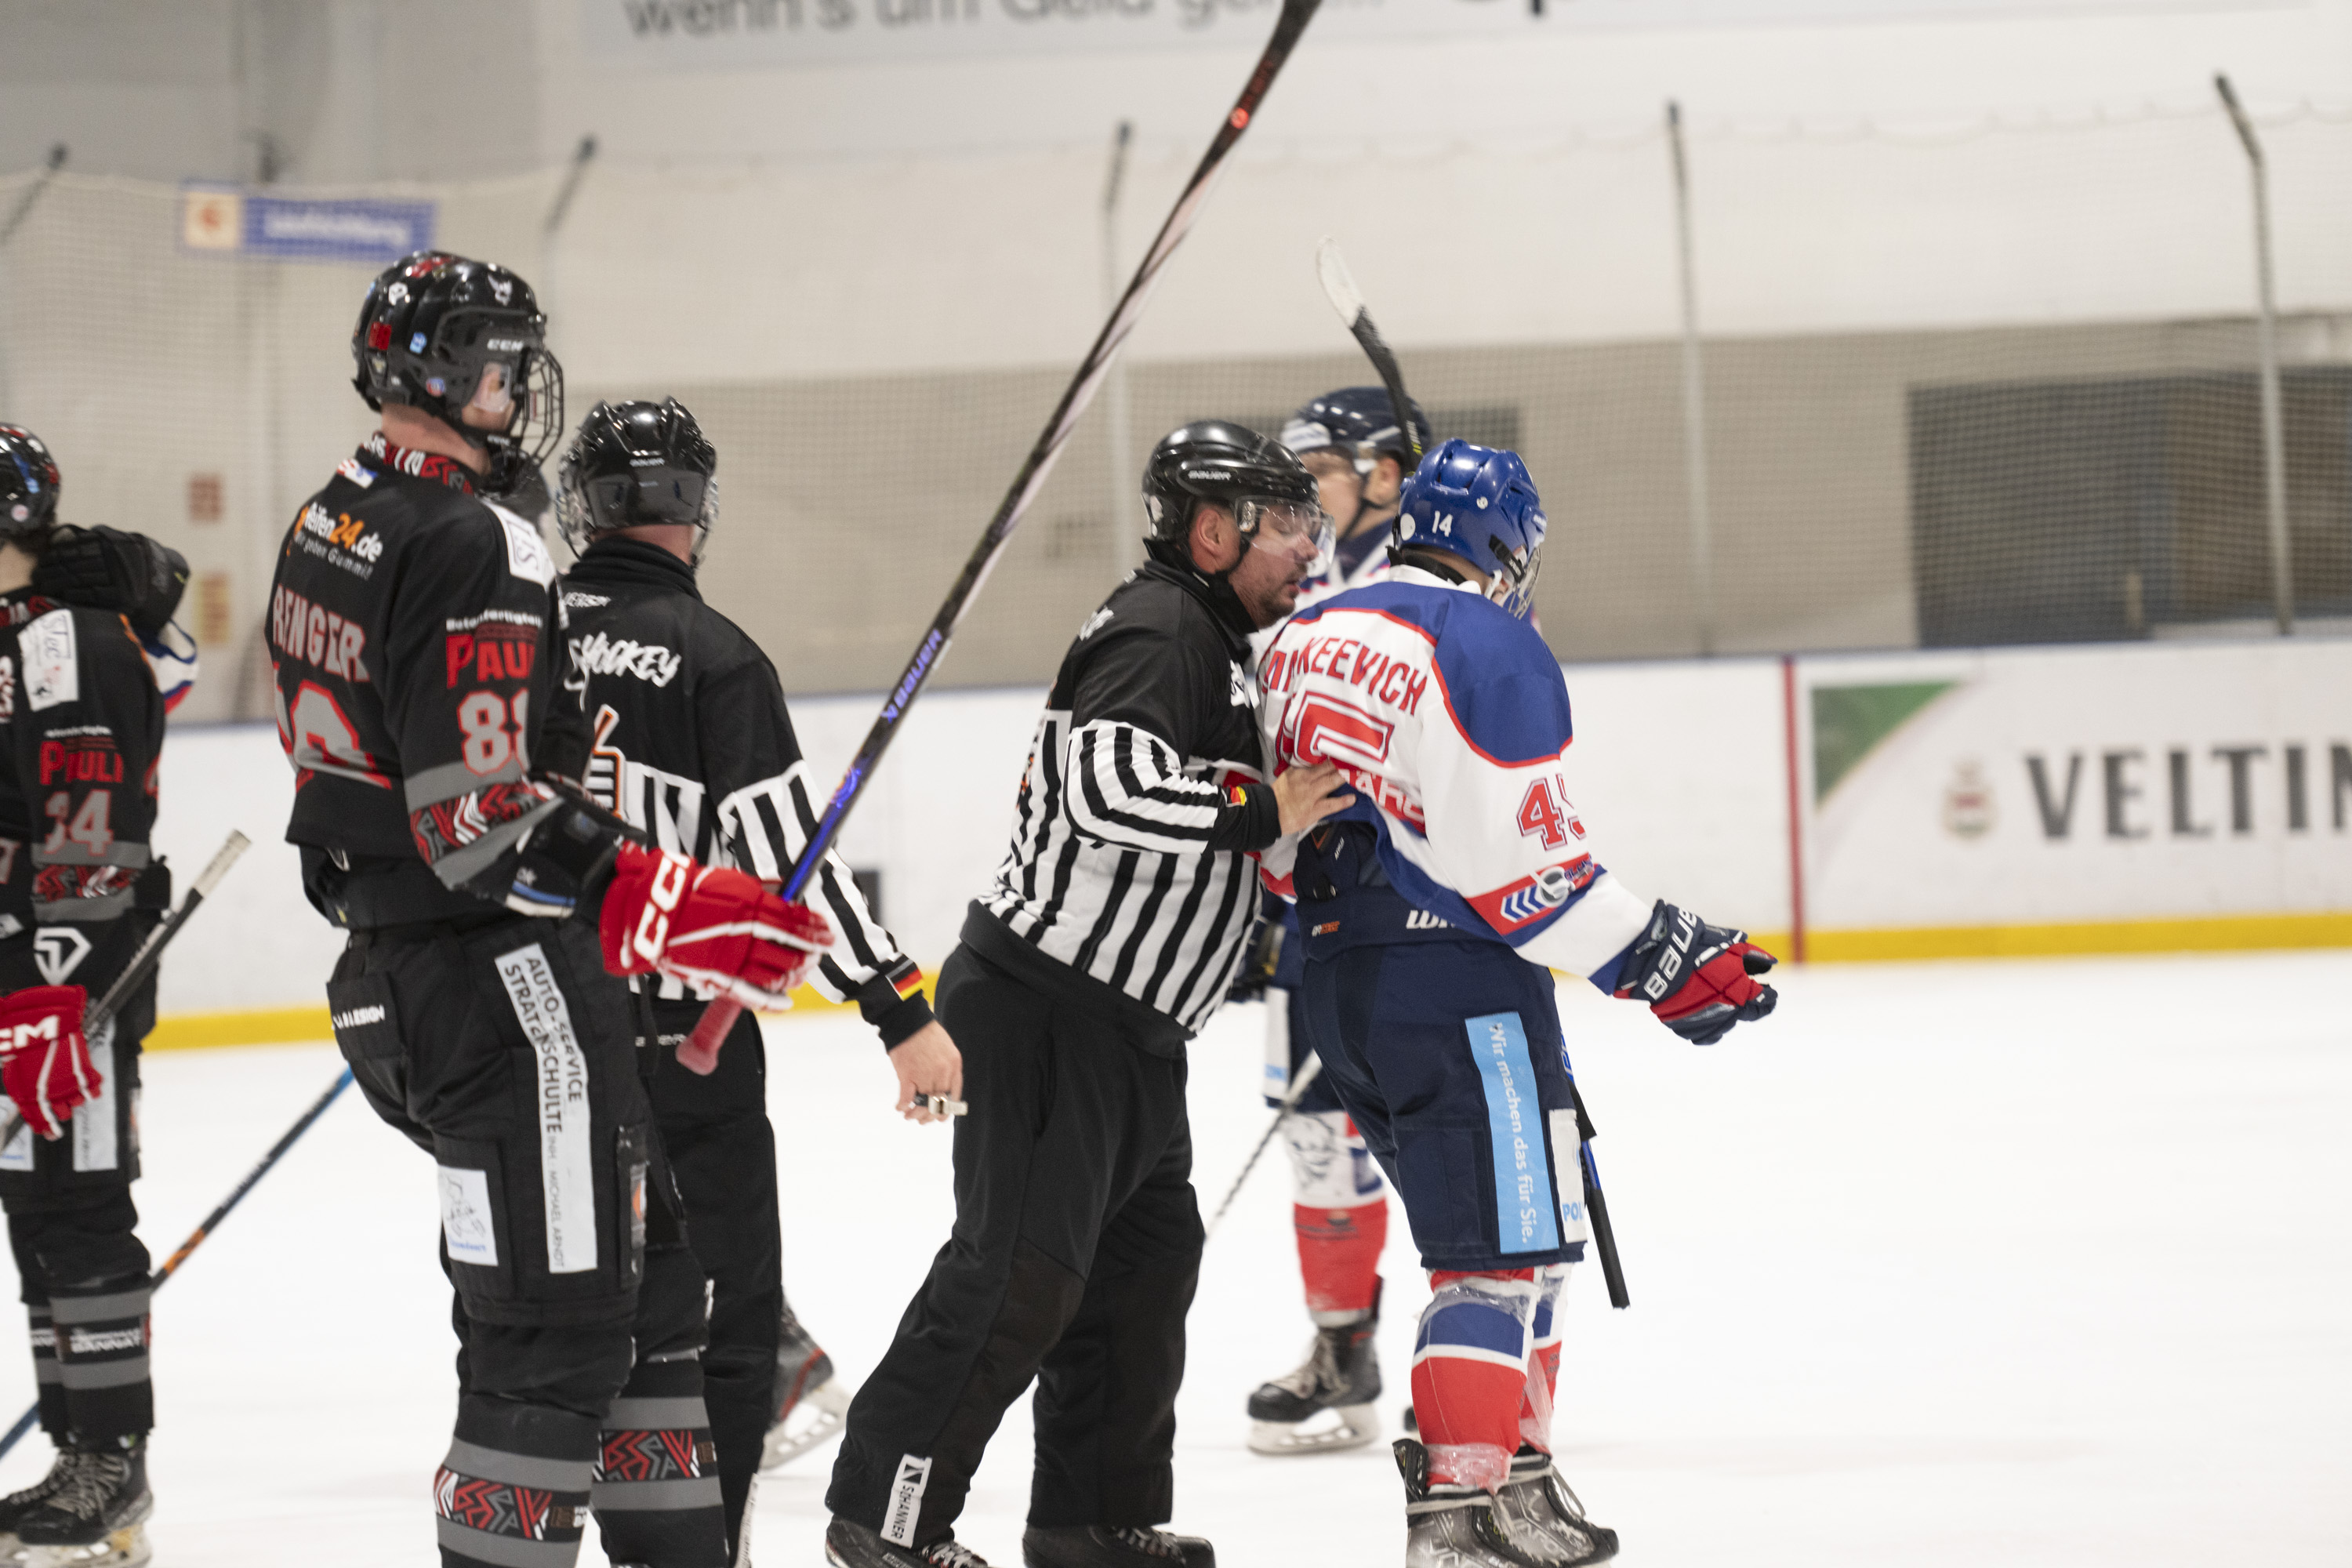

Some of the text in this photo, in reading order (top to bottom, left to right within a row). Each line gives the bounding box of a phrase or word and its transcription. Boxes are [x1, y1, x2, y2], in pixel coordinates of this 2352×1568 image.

[1432, 510, 1454, 538] 14
[445, 633, 536, 690] PAU
[0, 1014, 60, 1051] M
[524, 957, 583, 1103] AUTO-SERVICE
[1489, 1022, 1537, 1244] Wir machen das für Sie.
